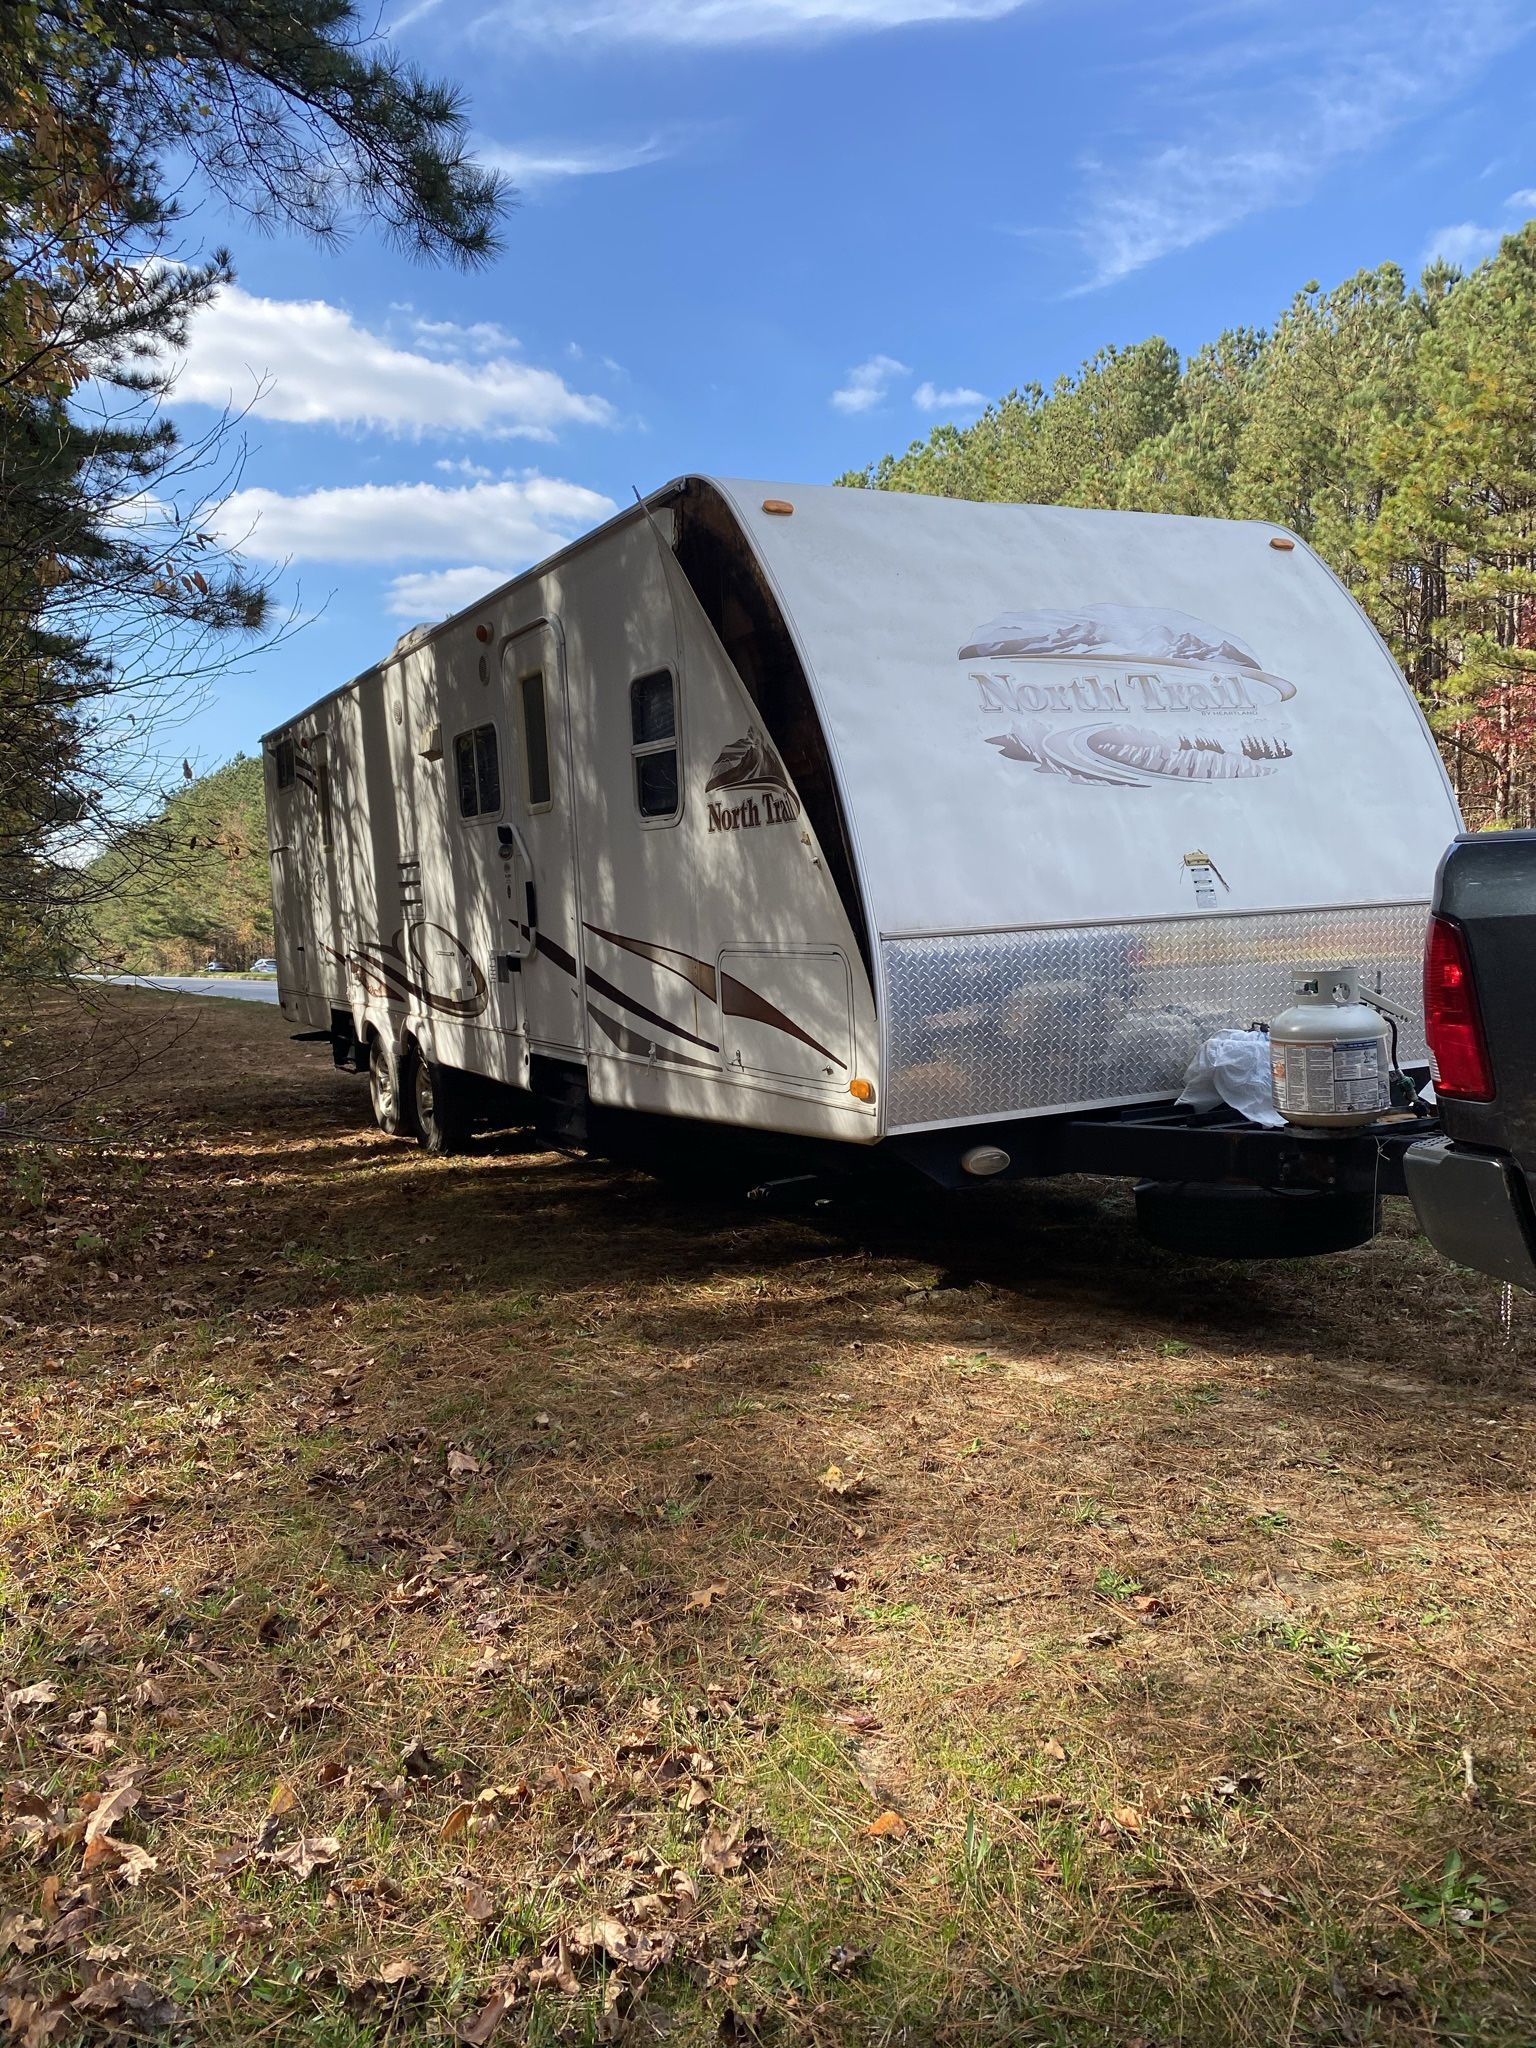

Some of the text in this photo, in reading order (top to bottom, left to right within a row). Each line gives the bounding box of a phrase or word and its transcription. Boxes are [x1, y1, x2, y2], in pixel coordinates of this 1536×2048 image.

[969, 672, 1257, 715] North Trail
[707, 791, 798, 833] North Trail
